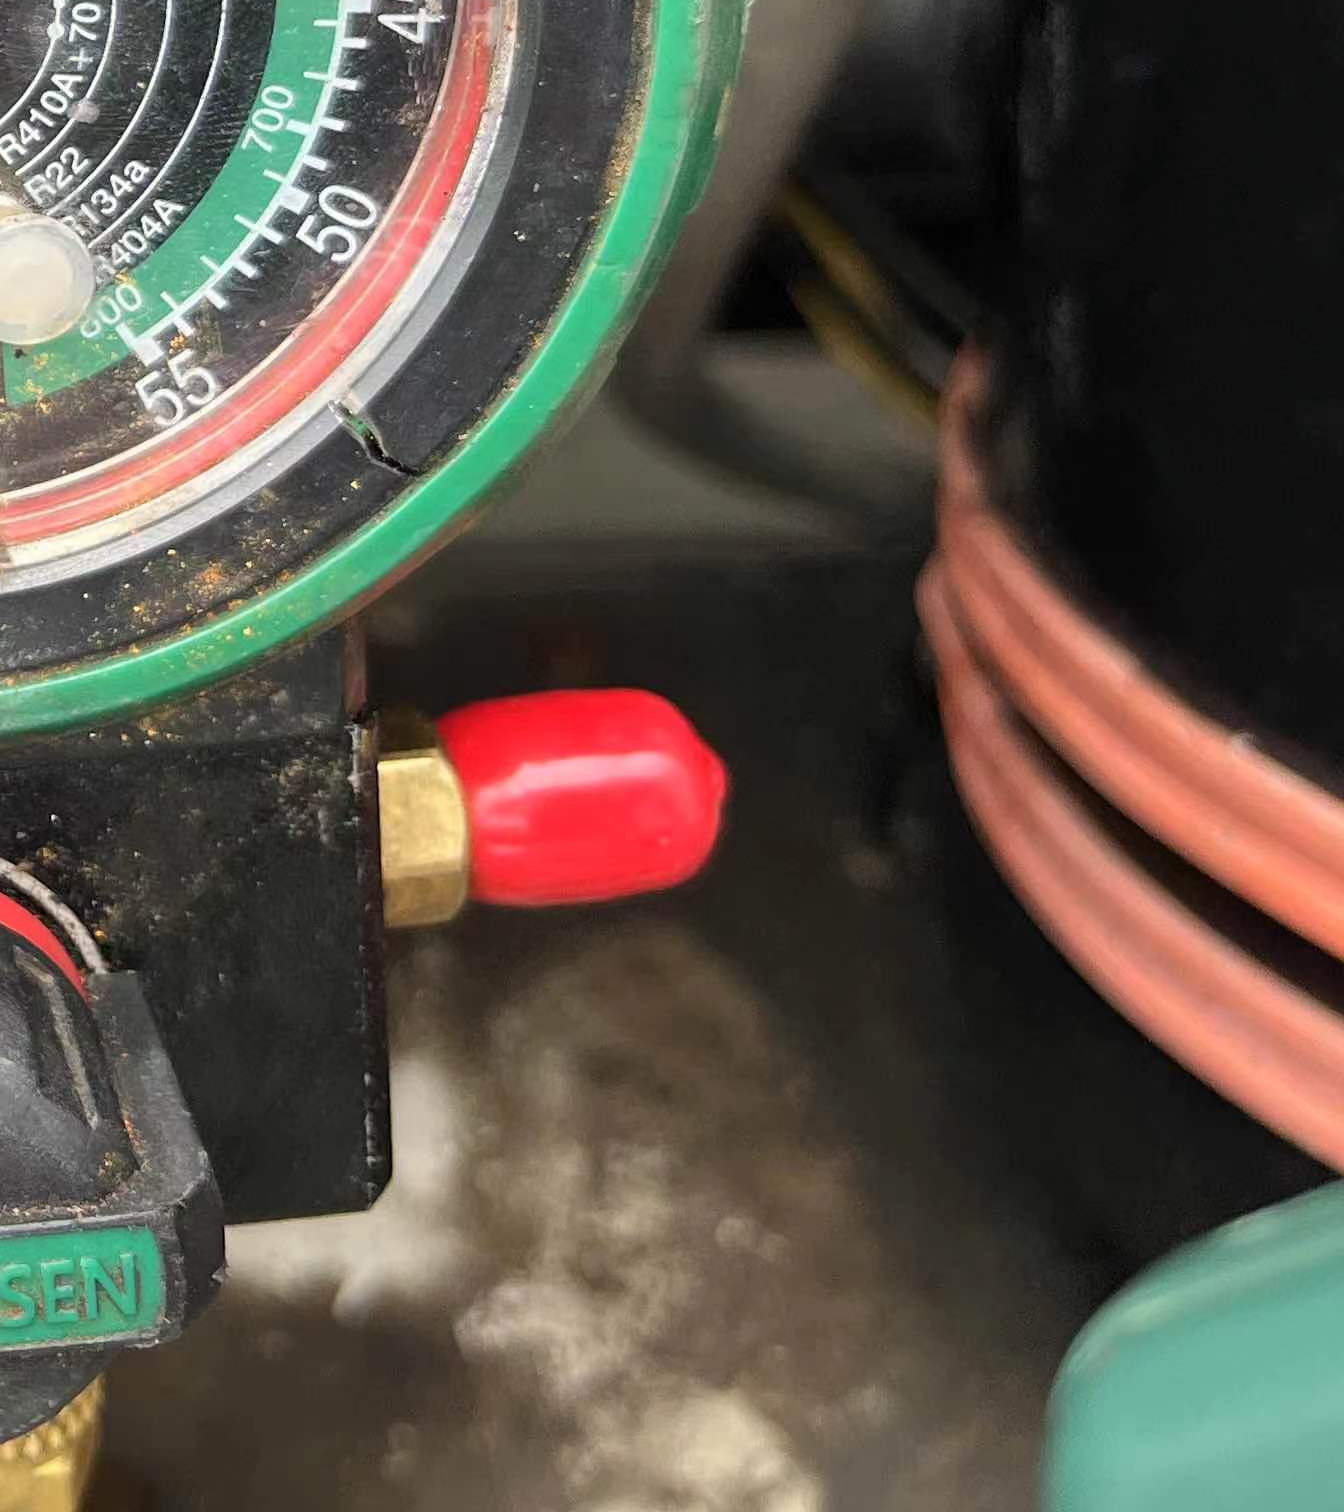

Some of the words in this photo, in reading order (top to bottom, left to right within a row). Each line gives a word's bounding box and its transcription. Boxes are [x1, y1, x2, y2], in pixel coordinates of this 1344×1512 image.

[241, 84, 295, 154] 700
[24, 146, 91, 206] R22
[296, 185, 378, 264] 50
[134, 349, 218, 427] 55
